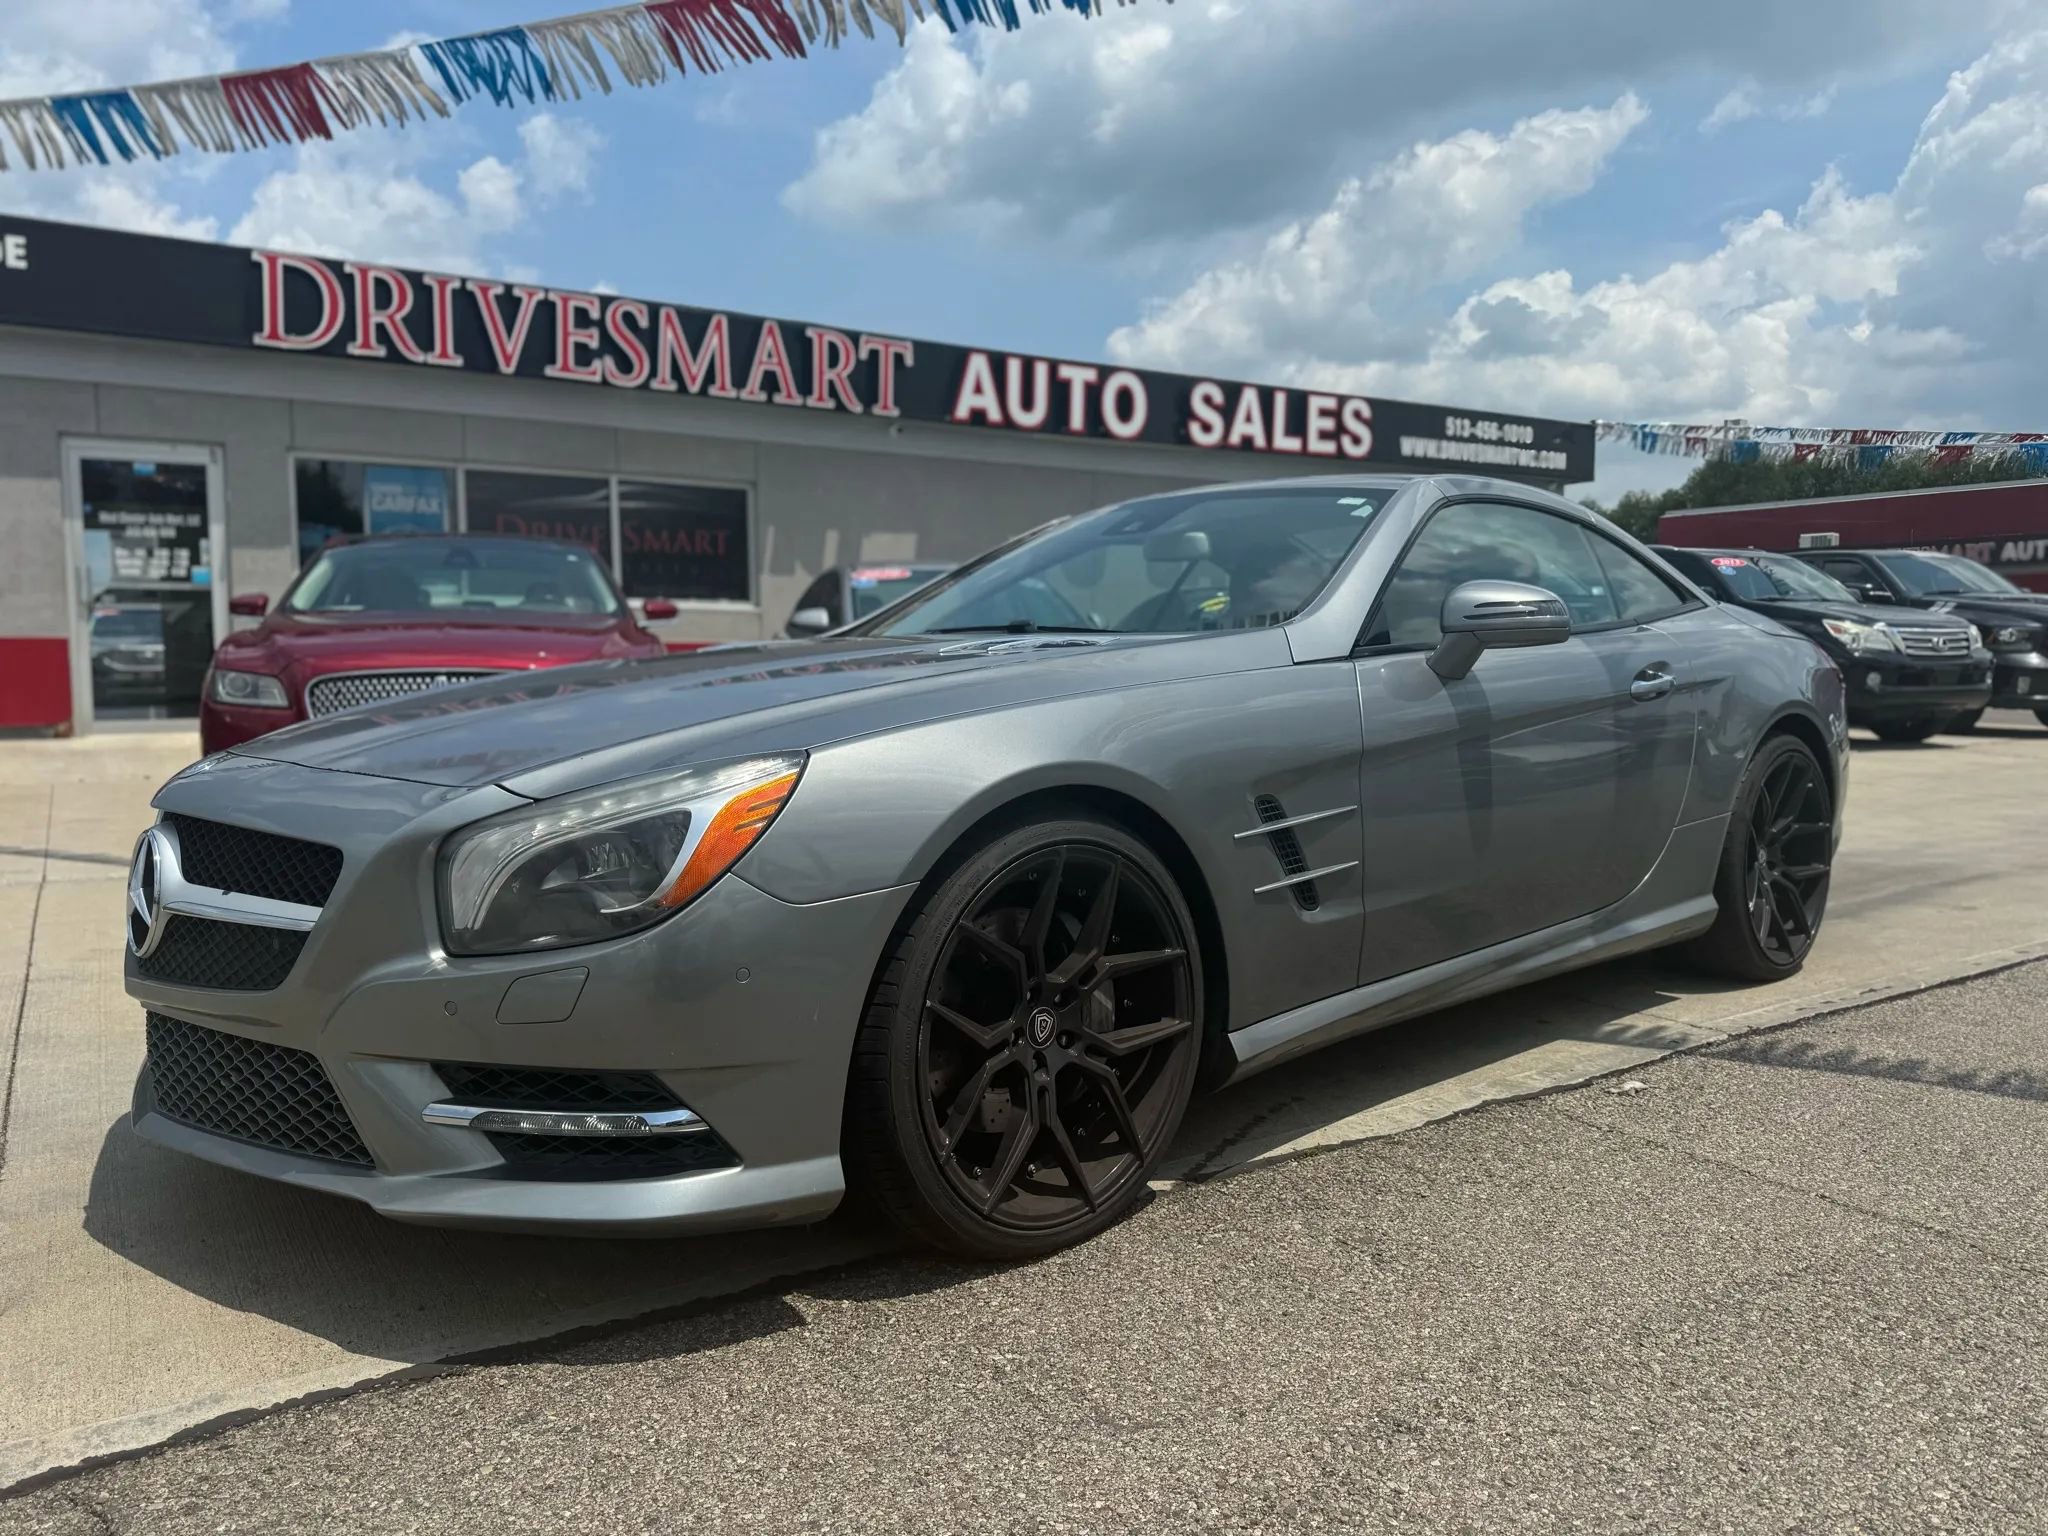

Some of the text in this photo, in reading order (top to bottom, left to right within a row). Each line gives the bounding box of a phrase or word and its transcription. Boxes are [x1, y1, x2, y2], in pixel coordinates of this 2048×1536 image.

[0, 233, 28, 271] E
[251, 250, 914, 417] DRIVESMART
[951, 349, 1375, 459] AUTO SALES
[371, 492, 441, 514] CARFAX
[622, 519, 730, 557] SMART
